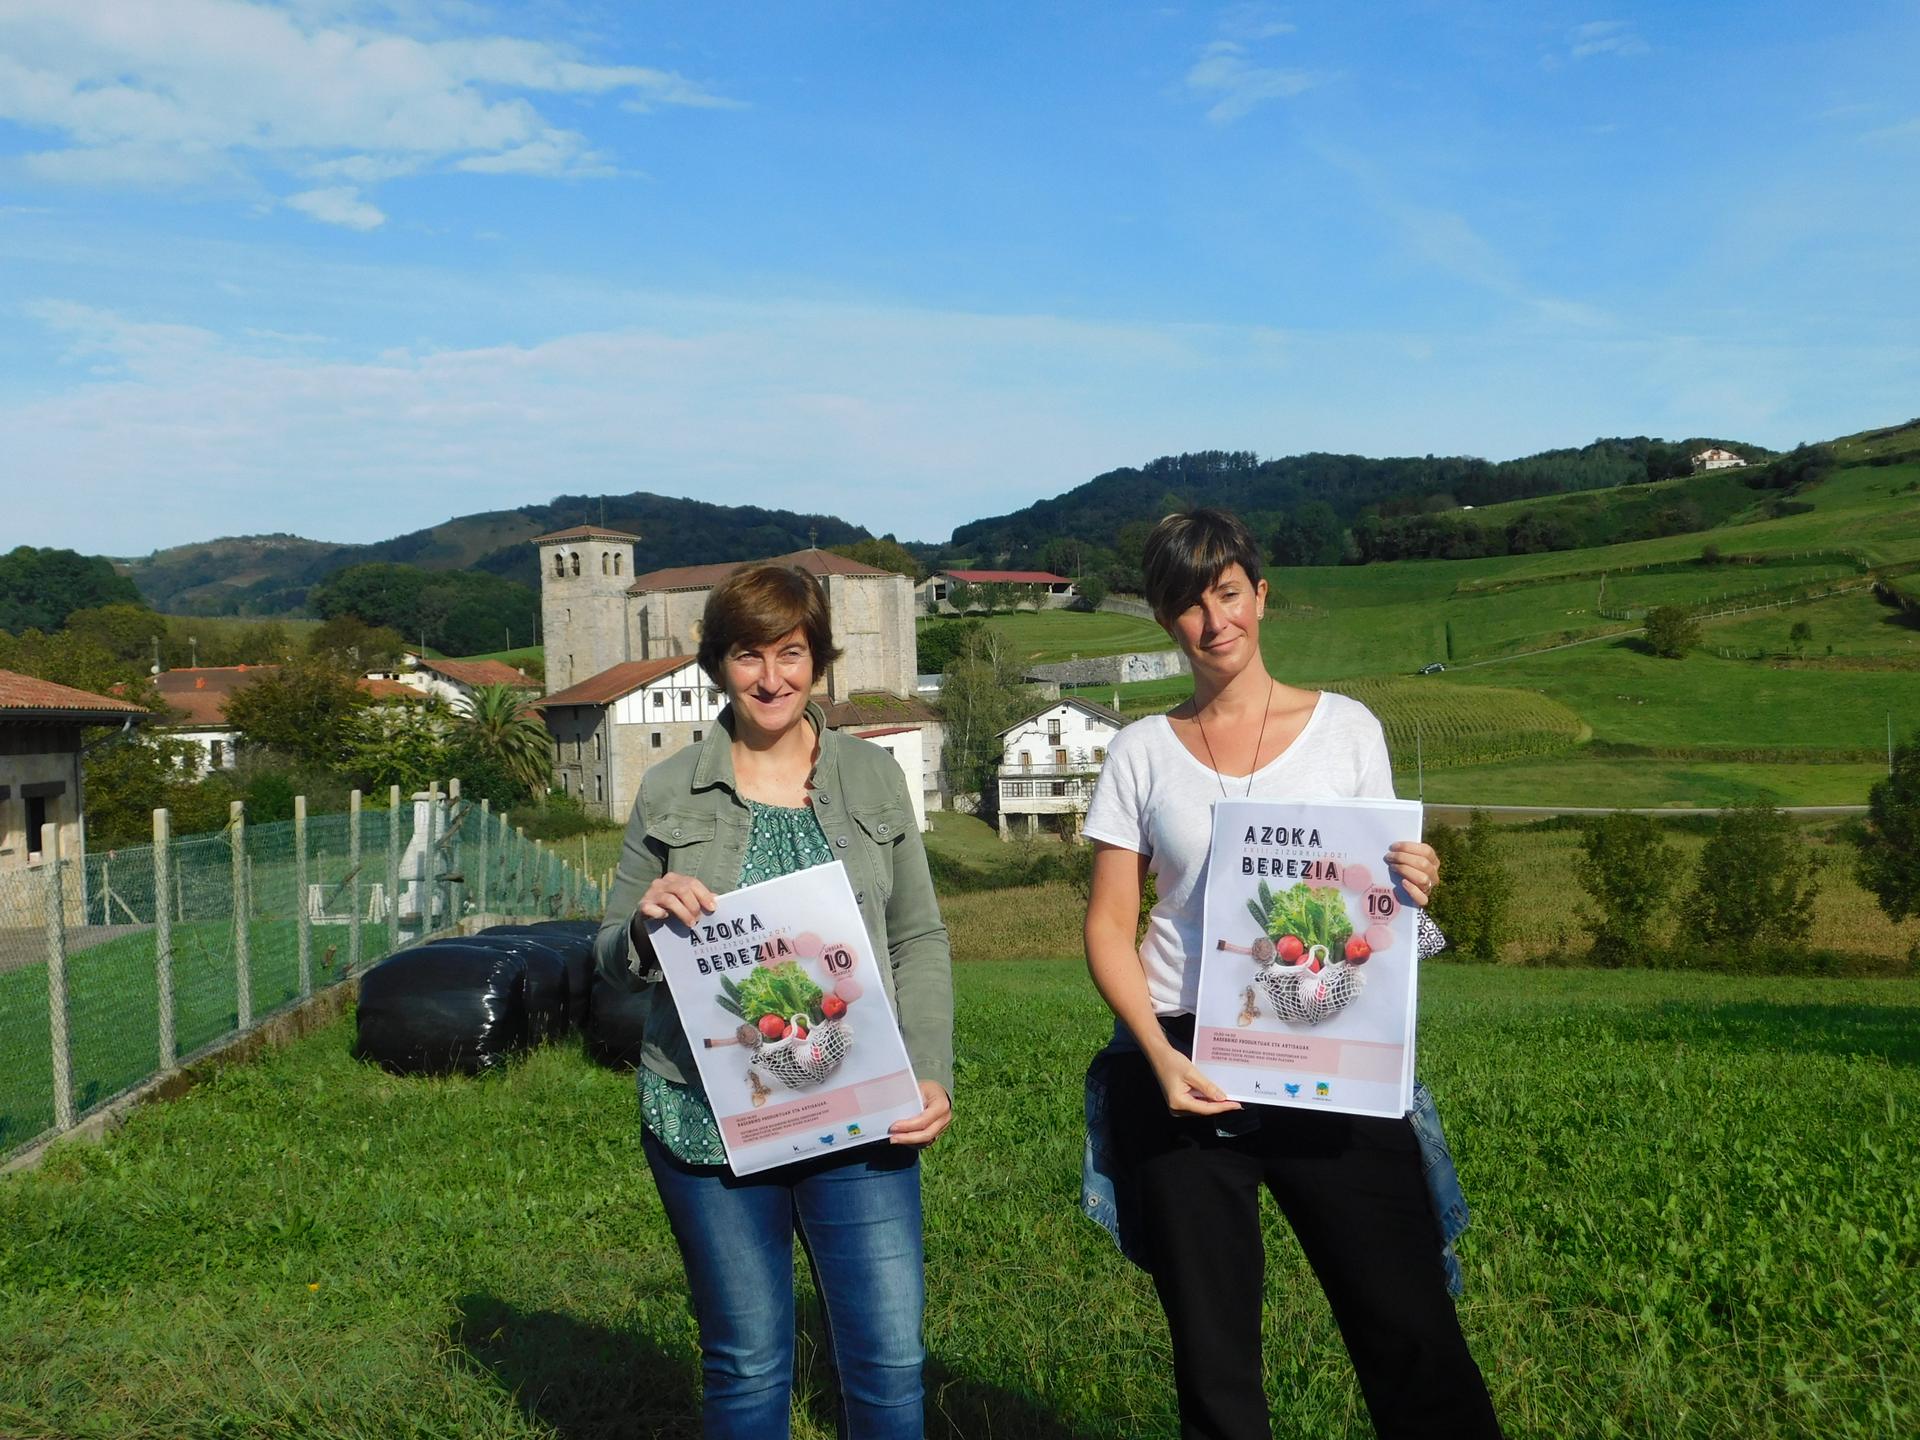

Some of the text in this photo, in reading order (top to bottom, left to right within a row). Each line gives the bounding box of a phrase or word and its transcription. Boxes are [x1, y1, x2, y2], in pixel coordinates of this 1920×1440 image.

[1244, 825, 1323, 848] AZOKA
[1242, 856, 1339, 881] BEREZIA
[1368, 894, 1394, 916] 10
[690, 913, 765, 947] AZOKA
[696, 938, 792, 975] BEREZIA
[824, 950, 852, 973] 10
